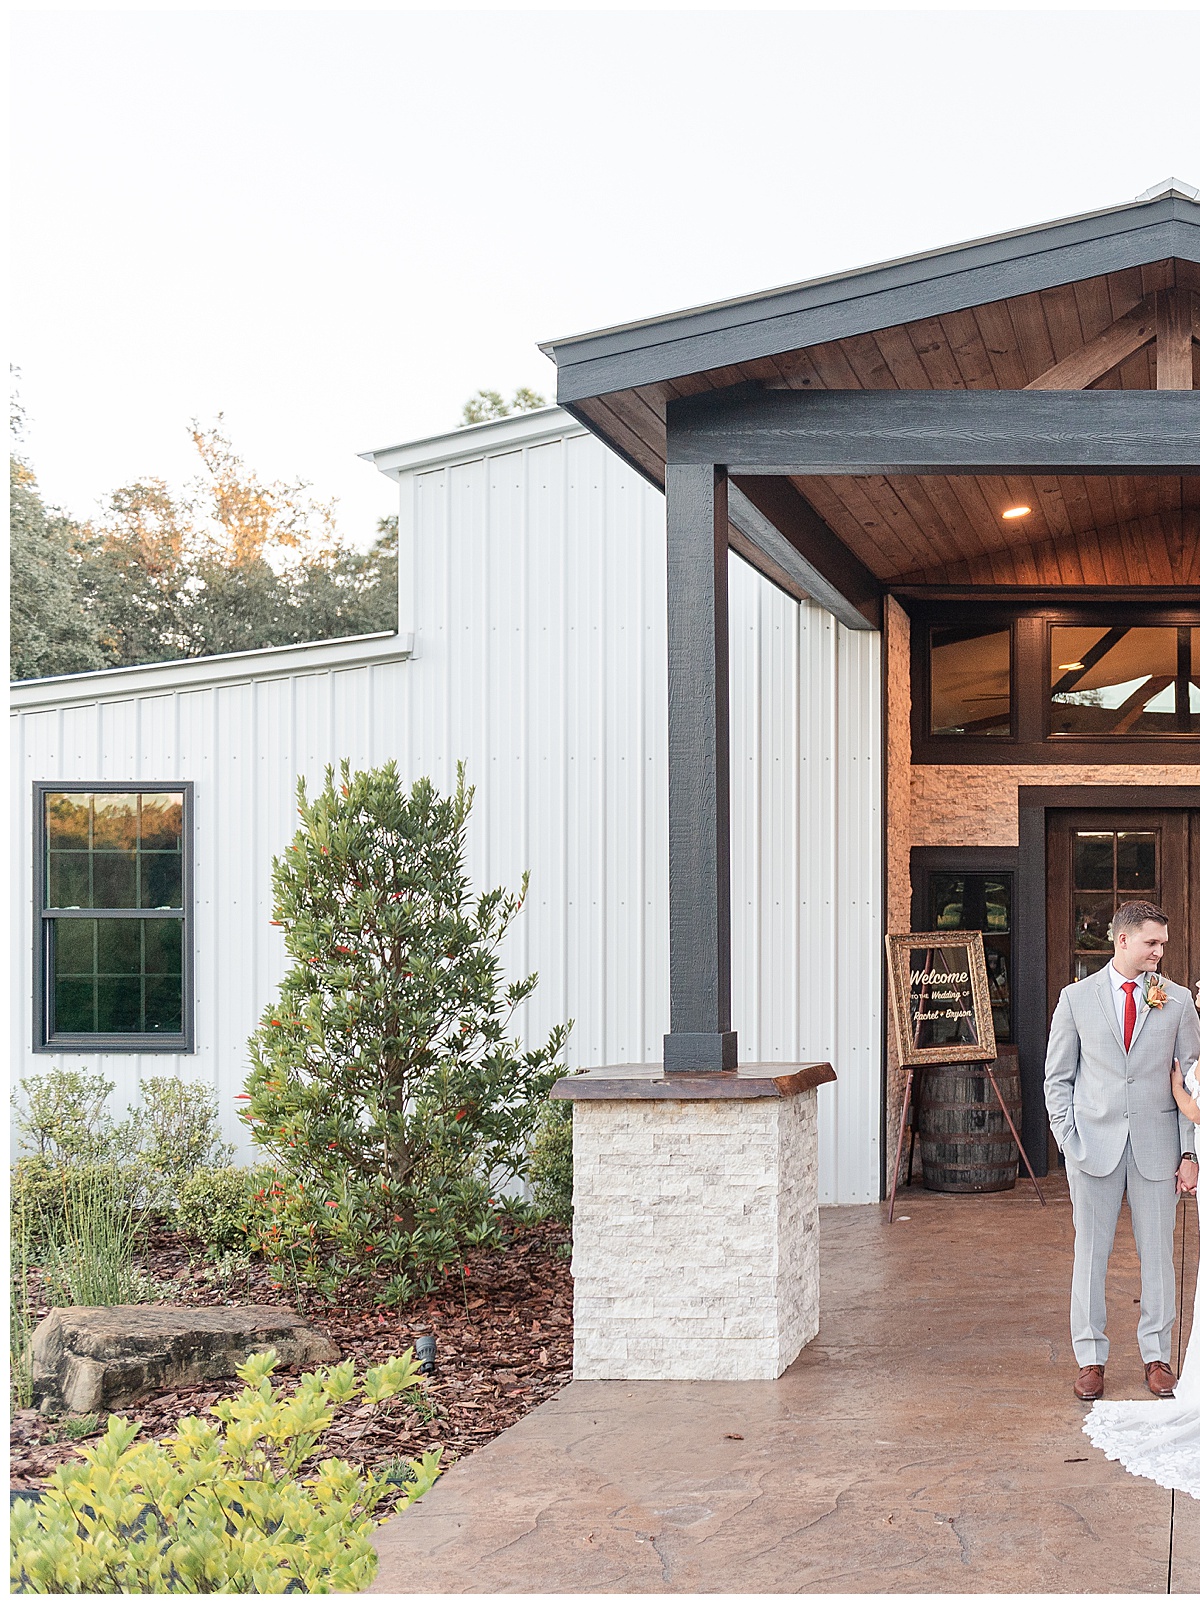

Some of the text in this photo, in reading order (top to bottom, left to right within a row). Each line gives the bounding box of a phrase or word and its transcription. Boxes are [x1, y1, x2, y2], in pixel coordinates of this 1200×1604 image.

[910, 969, 969, 986] Welcome
[931, 990, 961, 1002] Wedding
[913, 1010, 939, 1021] Rachel
[945, 1009, 972, 1022] Bryson
